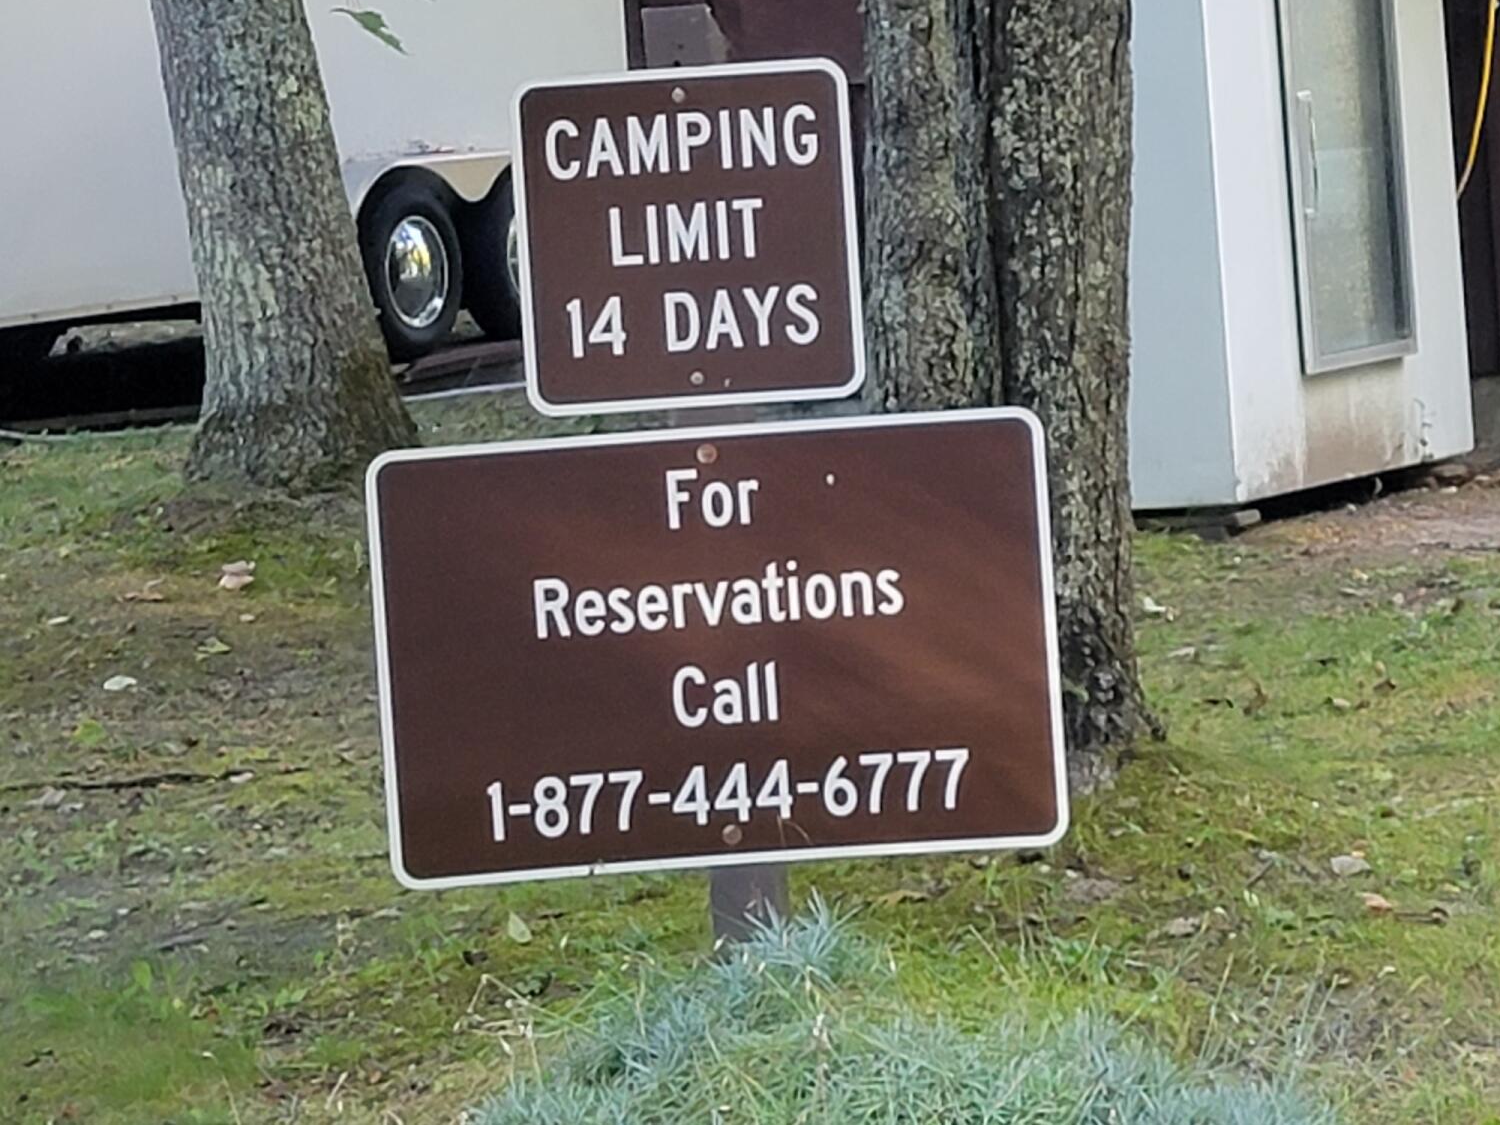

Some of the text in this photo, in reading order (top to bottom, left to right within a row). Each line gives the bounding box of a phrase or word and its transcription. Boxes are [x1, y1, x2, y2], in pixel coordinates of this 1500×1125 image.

[544, 104, 819, 182] CAMPING
[607, 197, 764, 268] LIMIT
[565, 283, 820, 359] 14 DAYS
[664, 468, 760, 531] For
[532, 560, 905, 639] Reservations
[671, 661, 780, 728] Call
[486, 748, 970, 842] 1-877-444-6777
